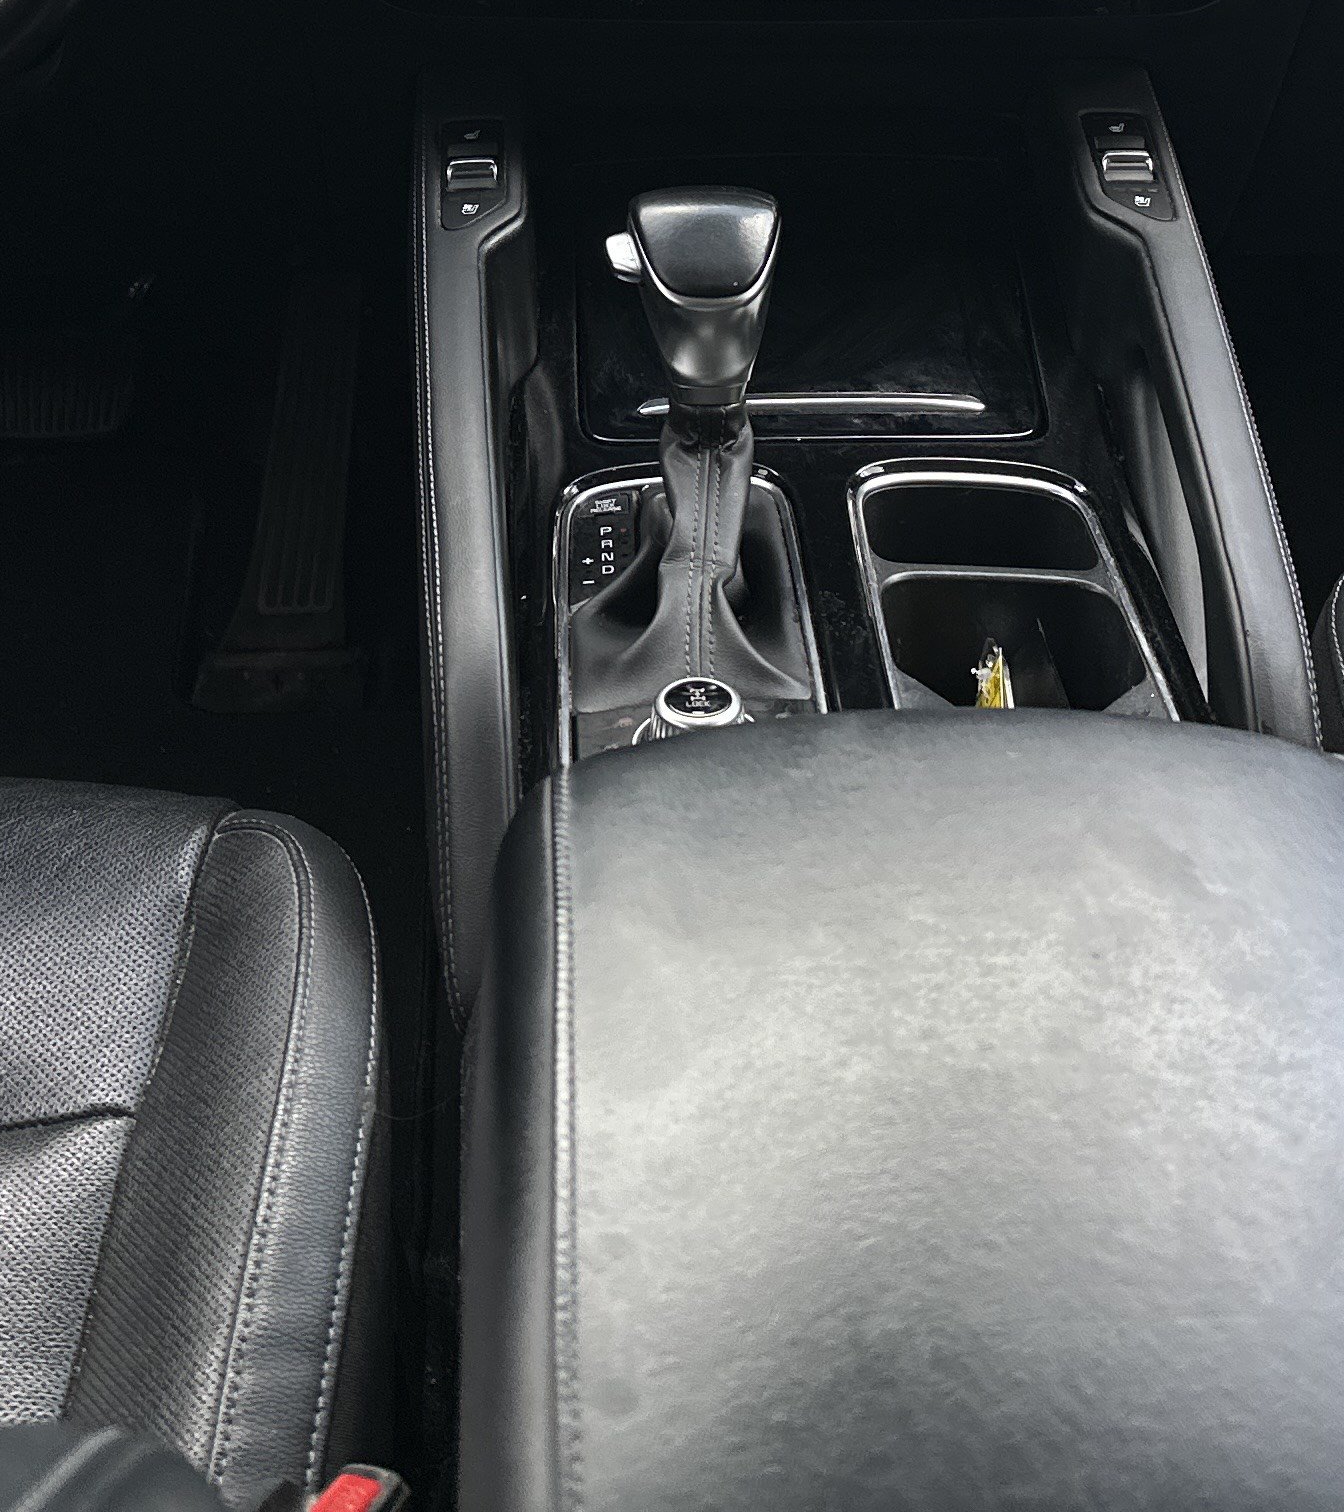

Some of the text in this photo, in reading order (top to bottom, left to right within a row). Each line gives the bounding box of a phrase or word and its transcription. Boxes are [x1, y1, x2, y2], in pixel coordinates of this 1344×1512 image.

[600, 526, 612, 536] P
[602, 552, 613, 561] N
[602, 565, 614, 574] D
